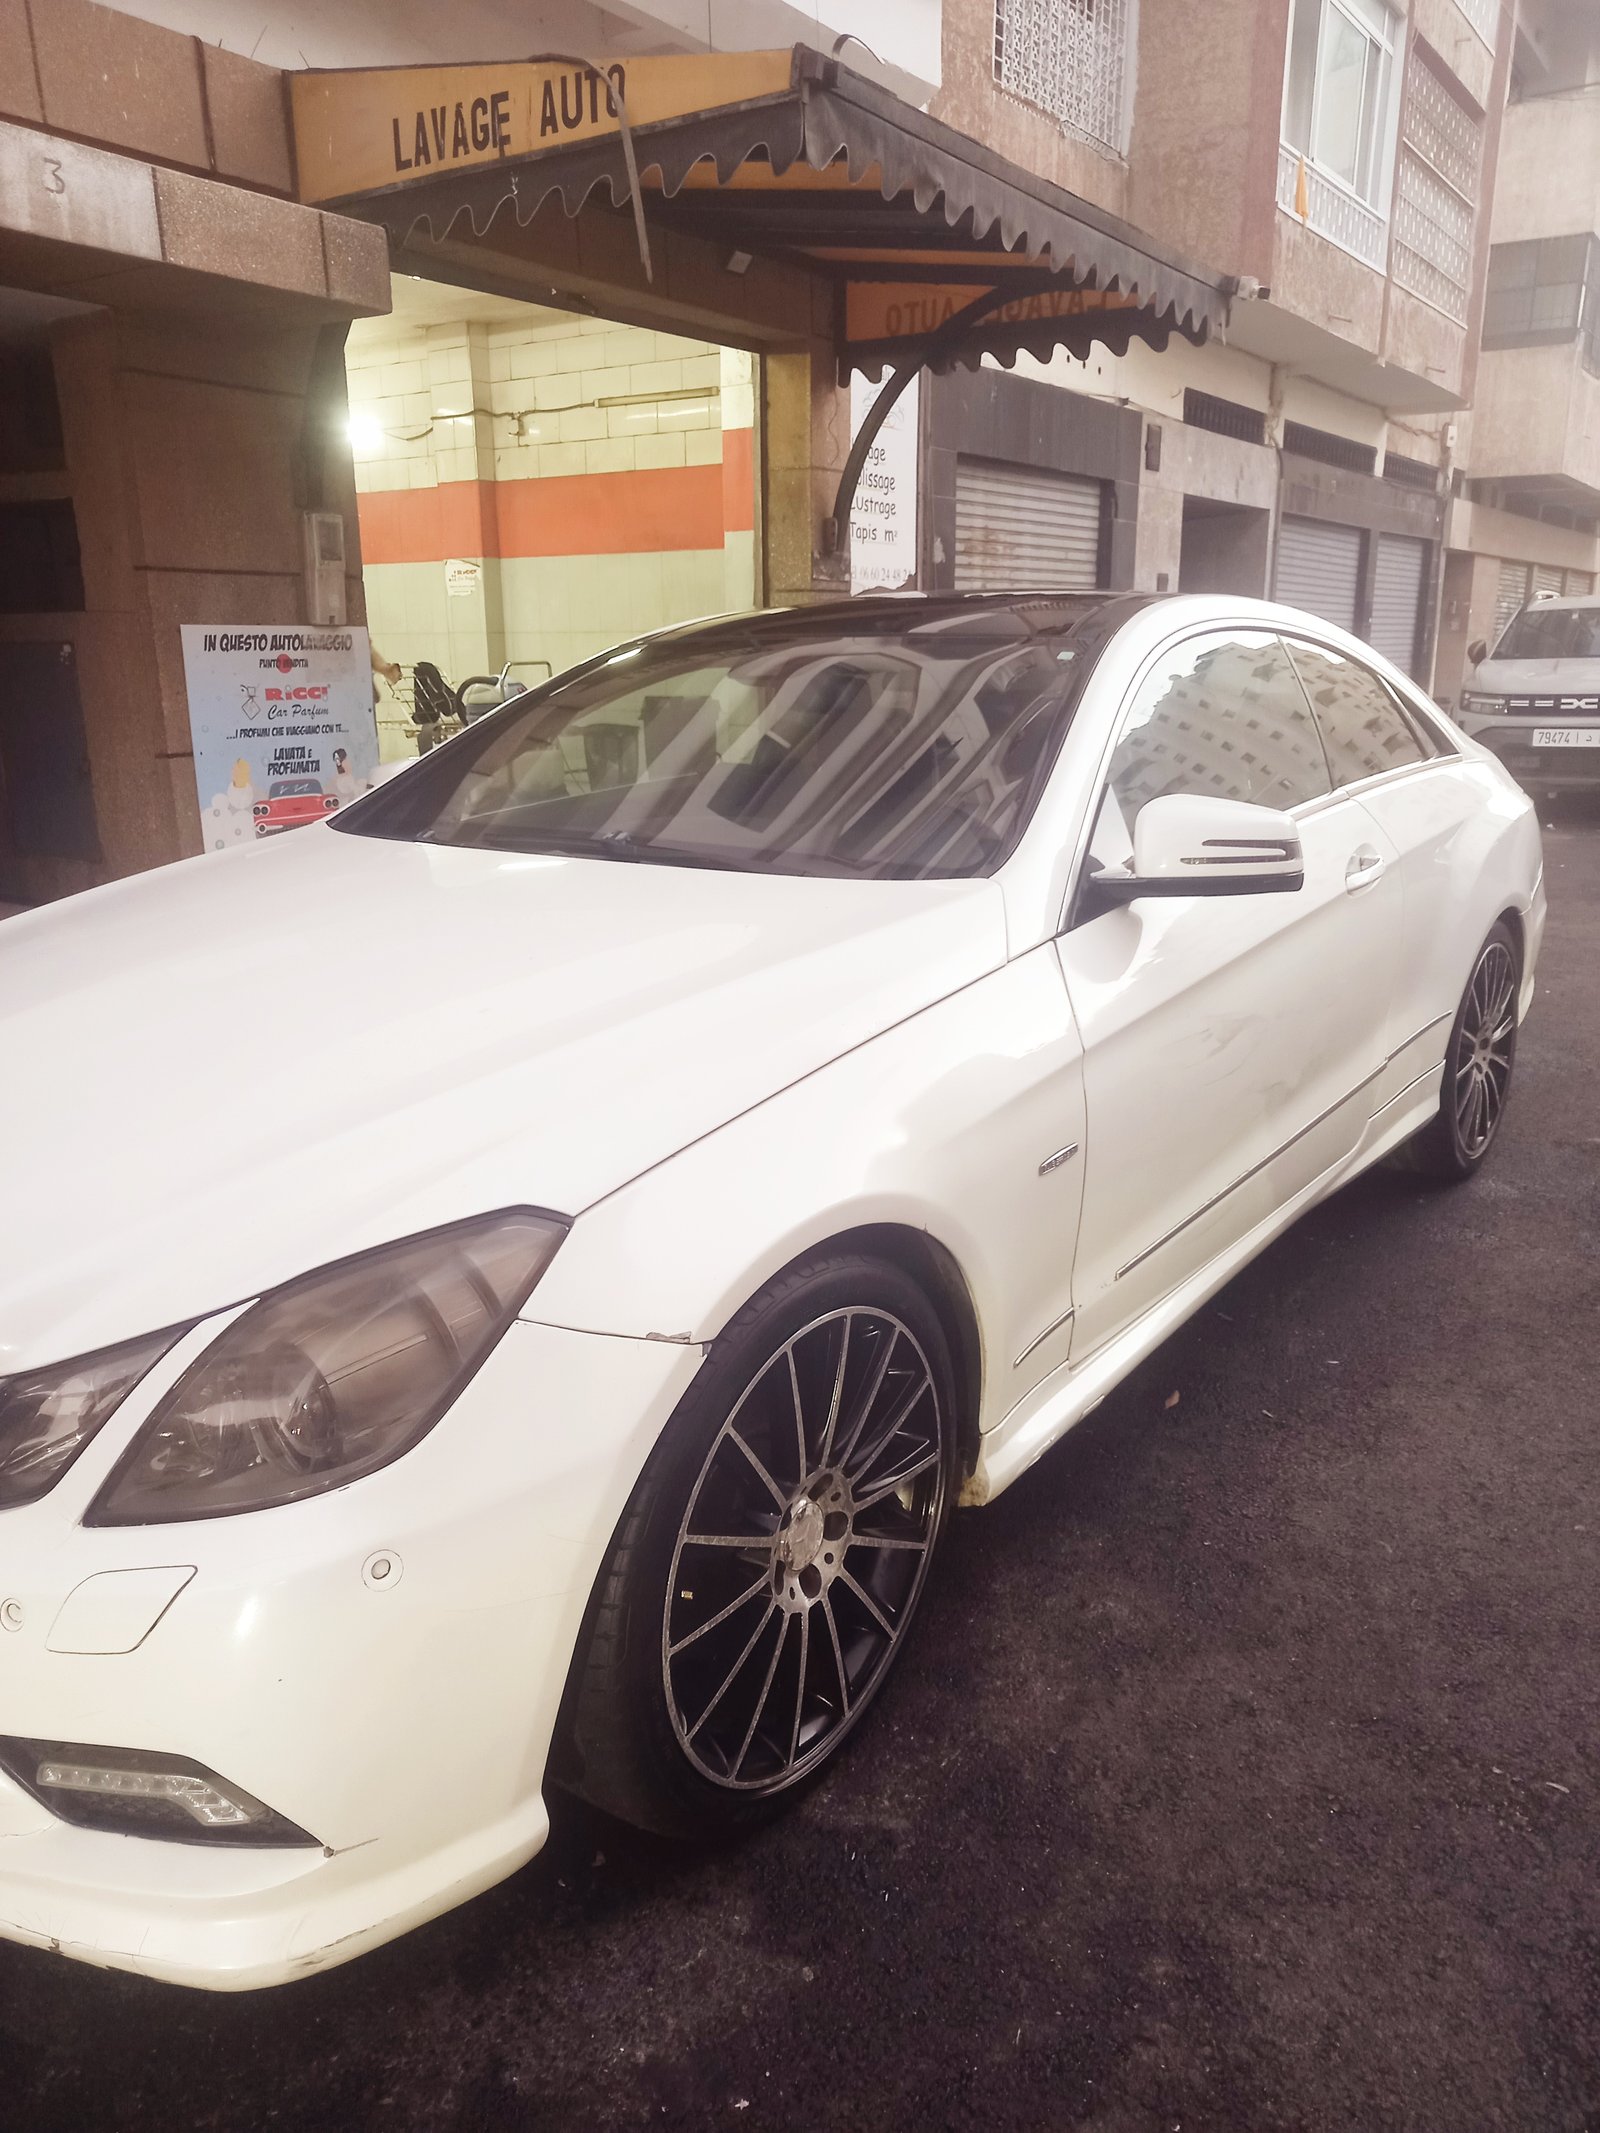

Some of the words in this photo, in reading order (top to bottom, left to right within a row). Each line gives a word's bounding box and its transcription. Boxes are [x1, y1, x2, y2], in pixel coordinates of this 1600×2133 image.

[393, 91, 512, 172] LAVAGE
[540, 64, 626, 137] AUTO
[43, 157, 66, 194] 3
[850, 521, 877, 544] Tapis
[204, 634, 217, 651] IN
[220, 633, 268, 652] QUESTO
[270, 633, 353, 651] AUTOLAVAGGIO
[267, 704, 288, 720] Car
[292, 704, 329, 719] Parfum
[239, 728, 271, 739] PROFUMI
[271, 726, 284, 736] CHE
[285, 725, 320, 736] VIAGGIANO
[321, 724, 334, 734] CON
[1538, 732, 1571, 744] 79474
[274, 746, 306, 761] LAVATA
[267, 759, 320, 776] PROFUMATA
